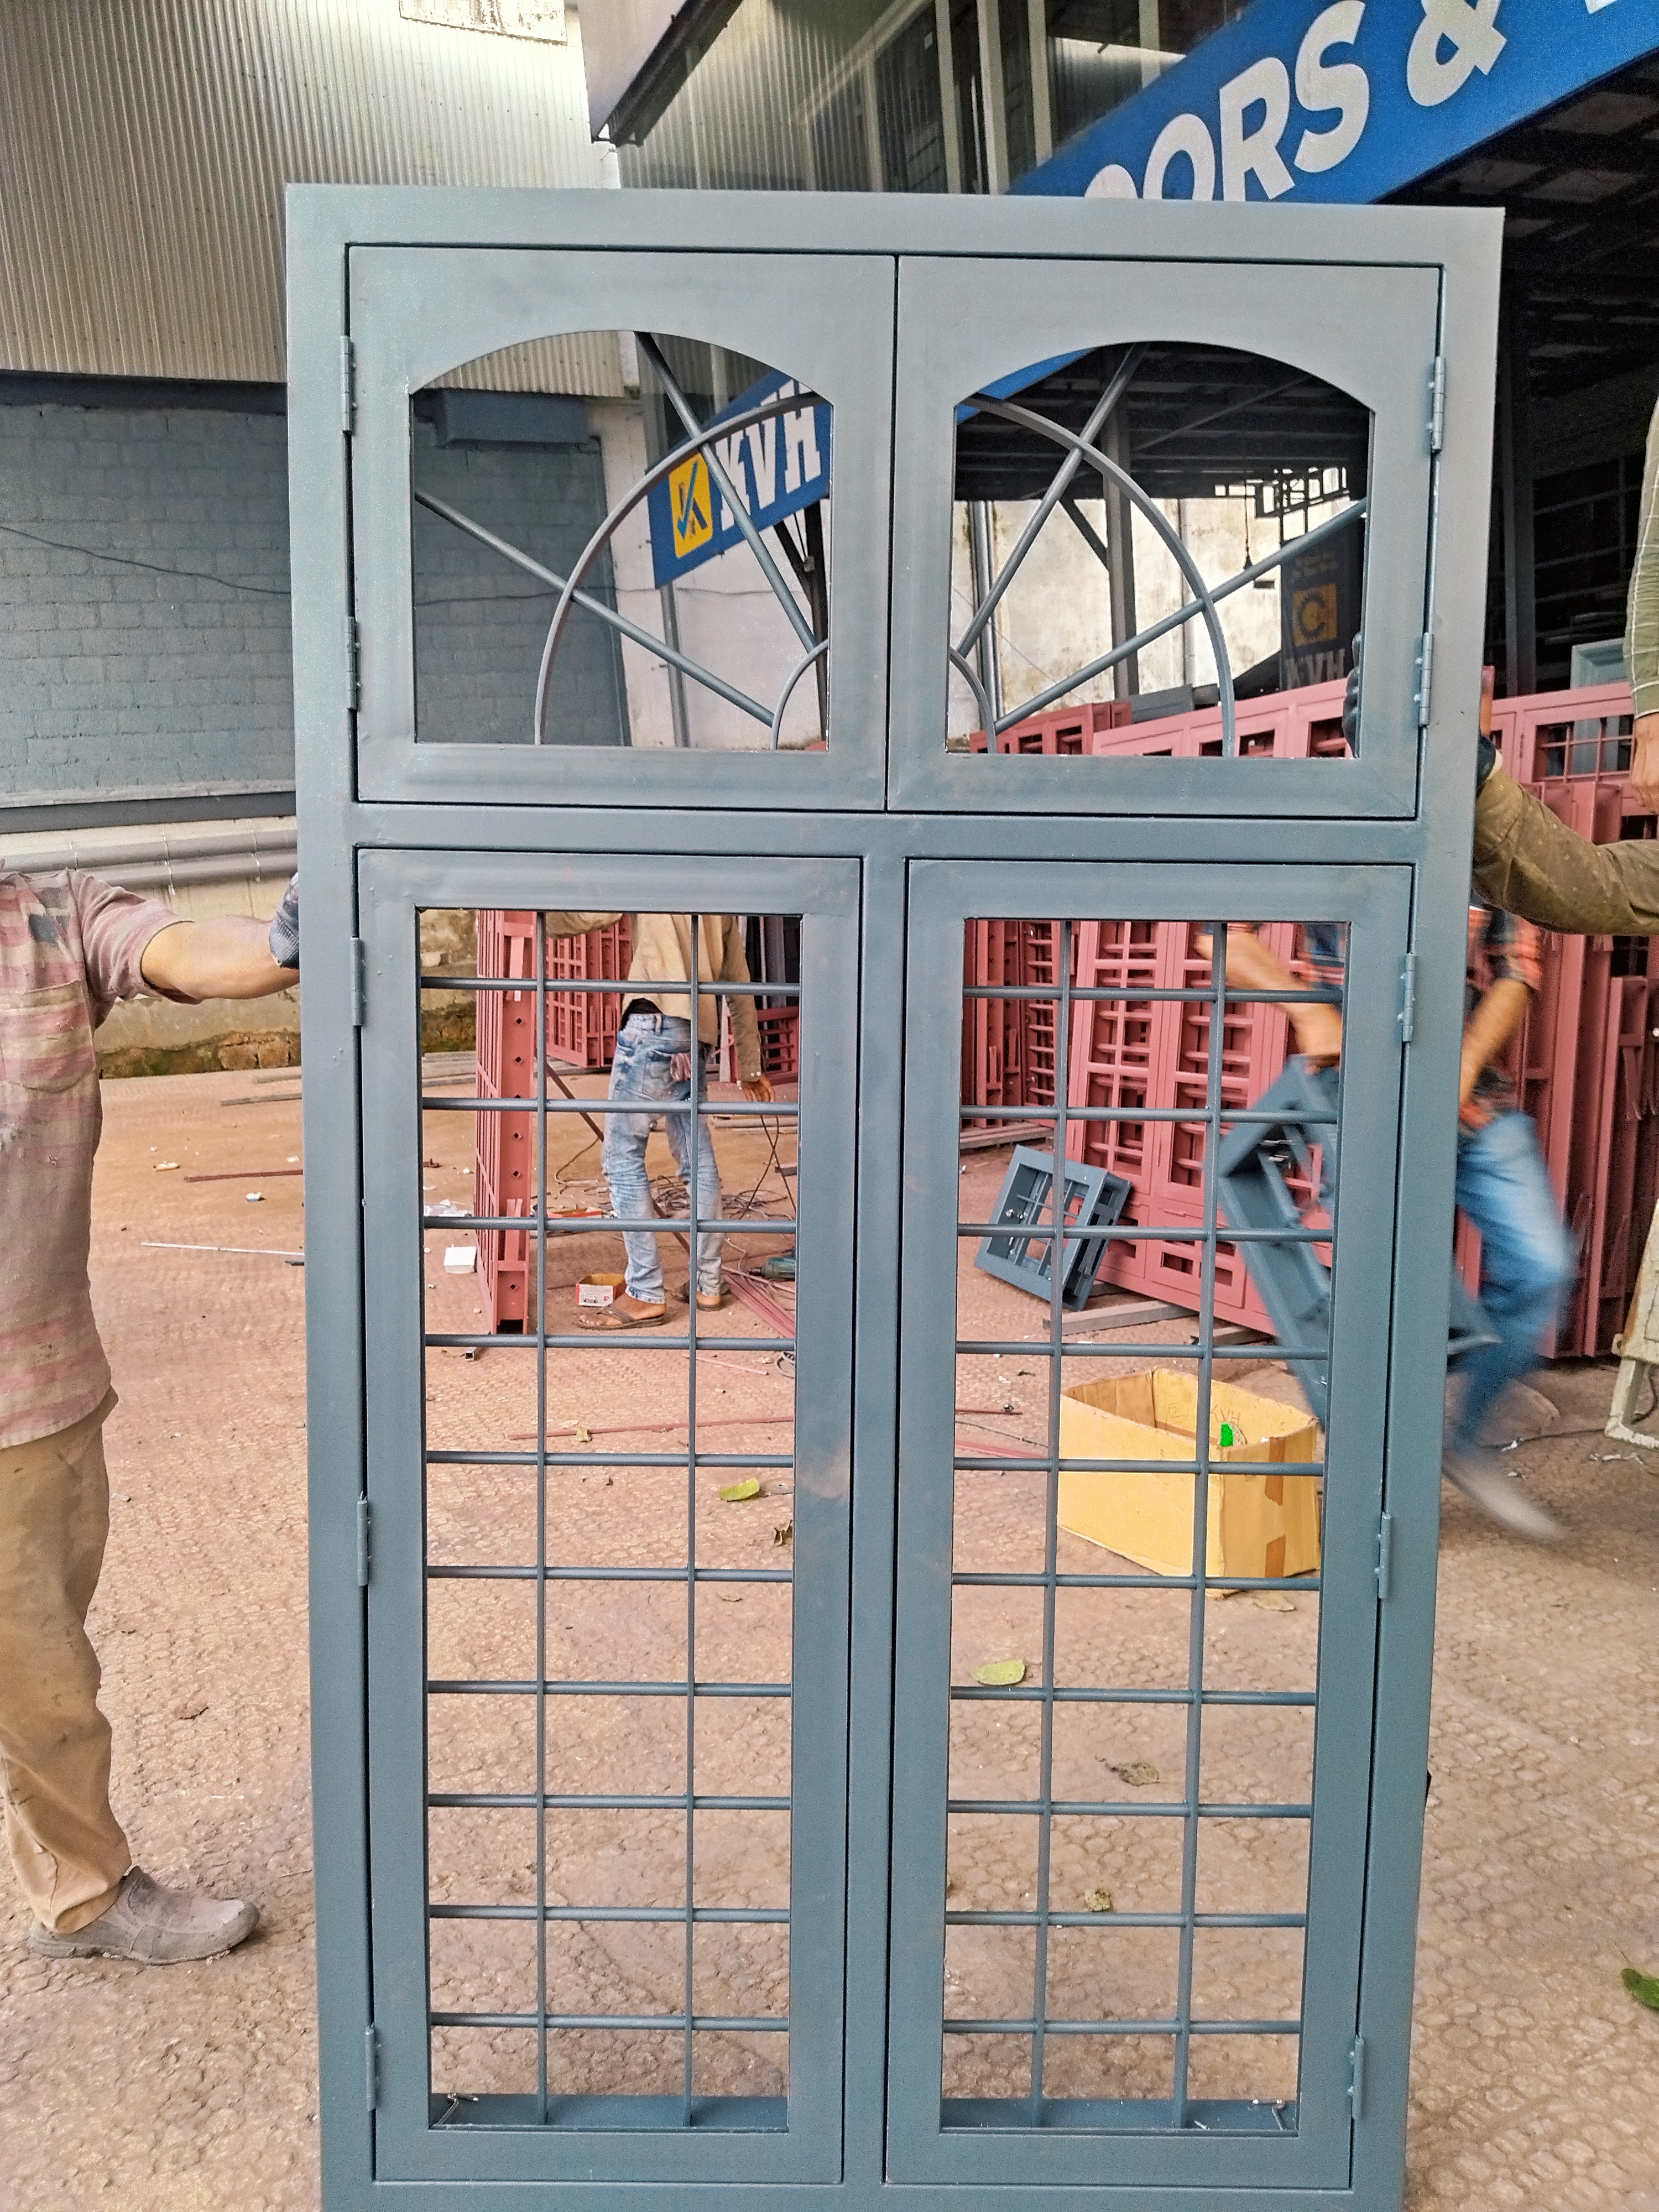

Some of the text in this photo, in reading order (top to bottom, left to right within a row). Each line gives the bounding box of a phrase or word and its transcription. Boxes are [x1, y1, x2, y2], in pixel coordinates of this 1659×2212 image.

[1084, 0, 1507, 202] ORS &
[716, 379, 822, 531] KVH
